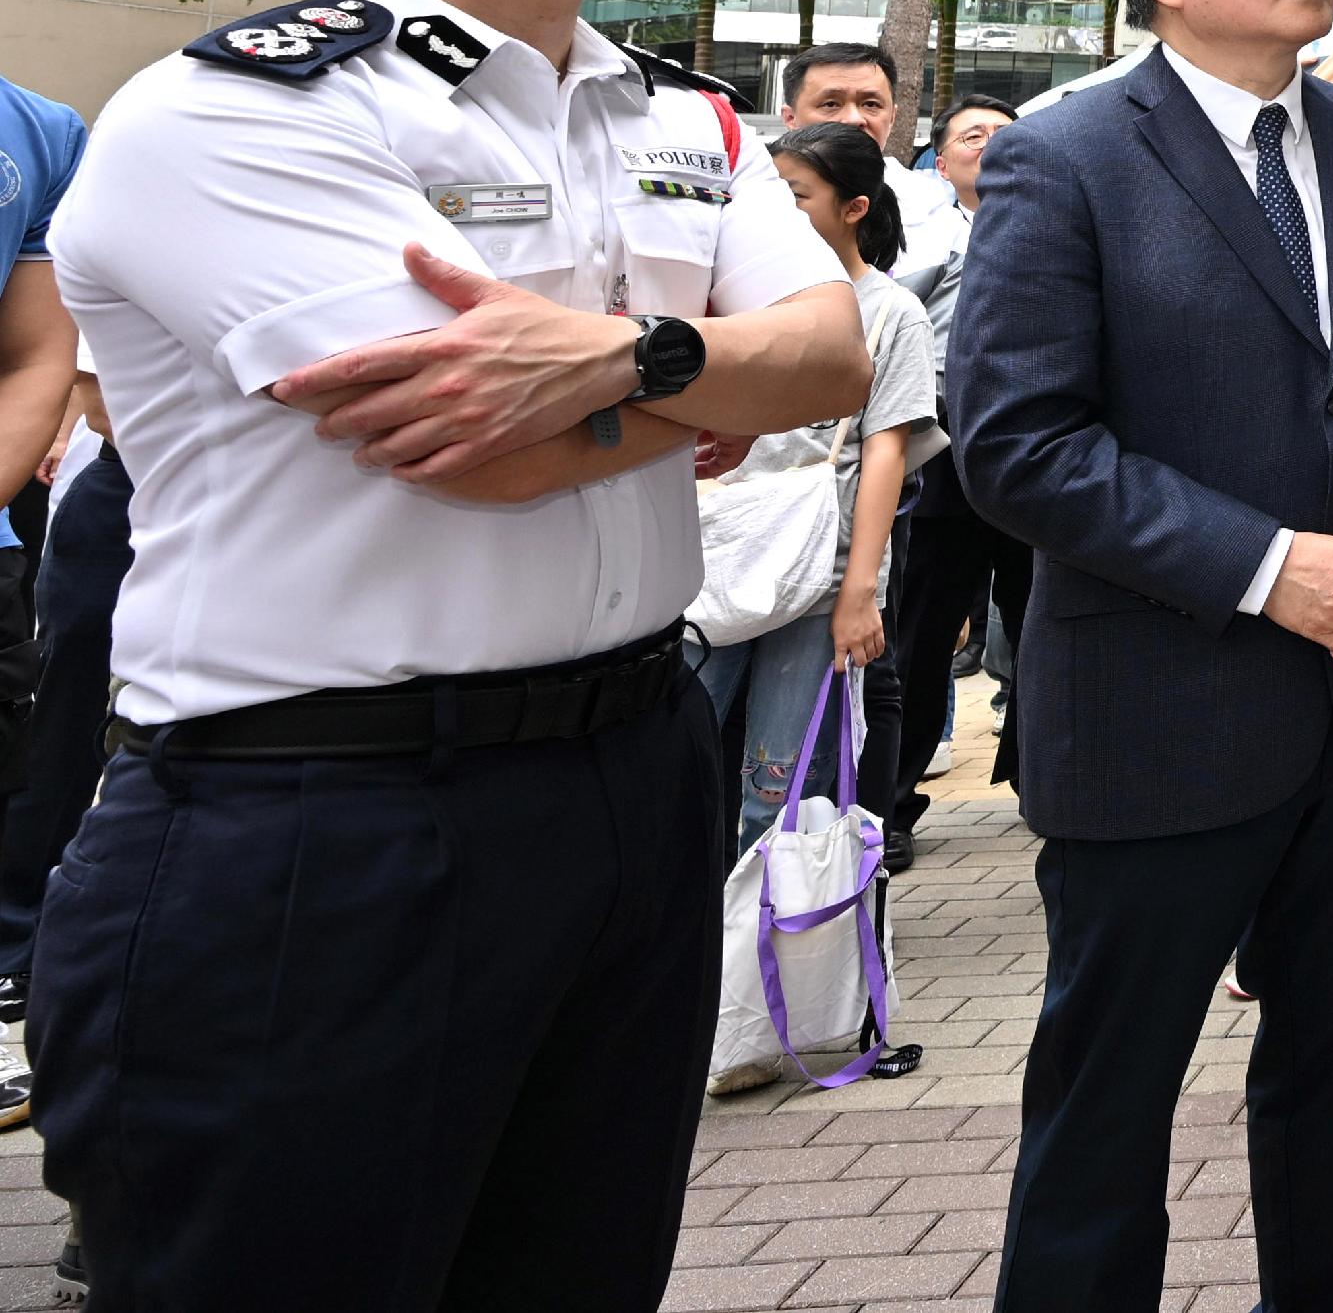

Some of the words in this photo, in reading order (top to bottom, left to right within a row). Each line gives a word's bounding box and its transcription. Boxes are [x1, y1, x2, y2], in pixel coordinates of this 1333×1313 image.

[622, 148, 641, 167] 警
[645, 151, 708, 170] POLICE
[709, 156, 723, 174] 察
